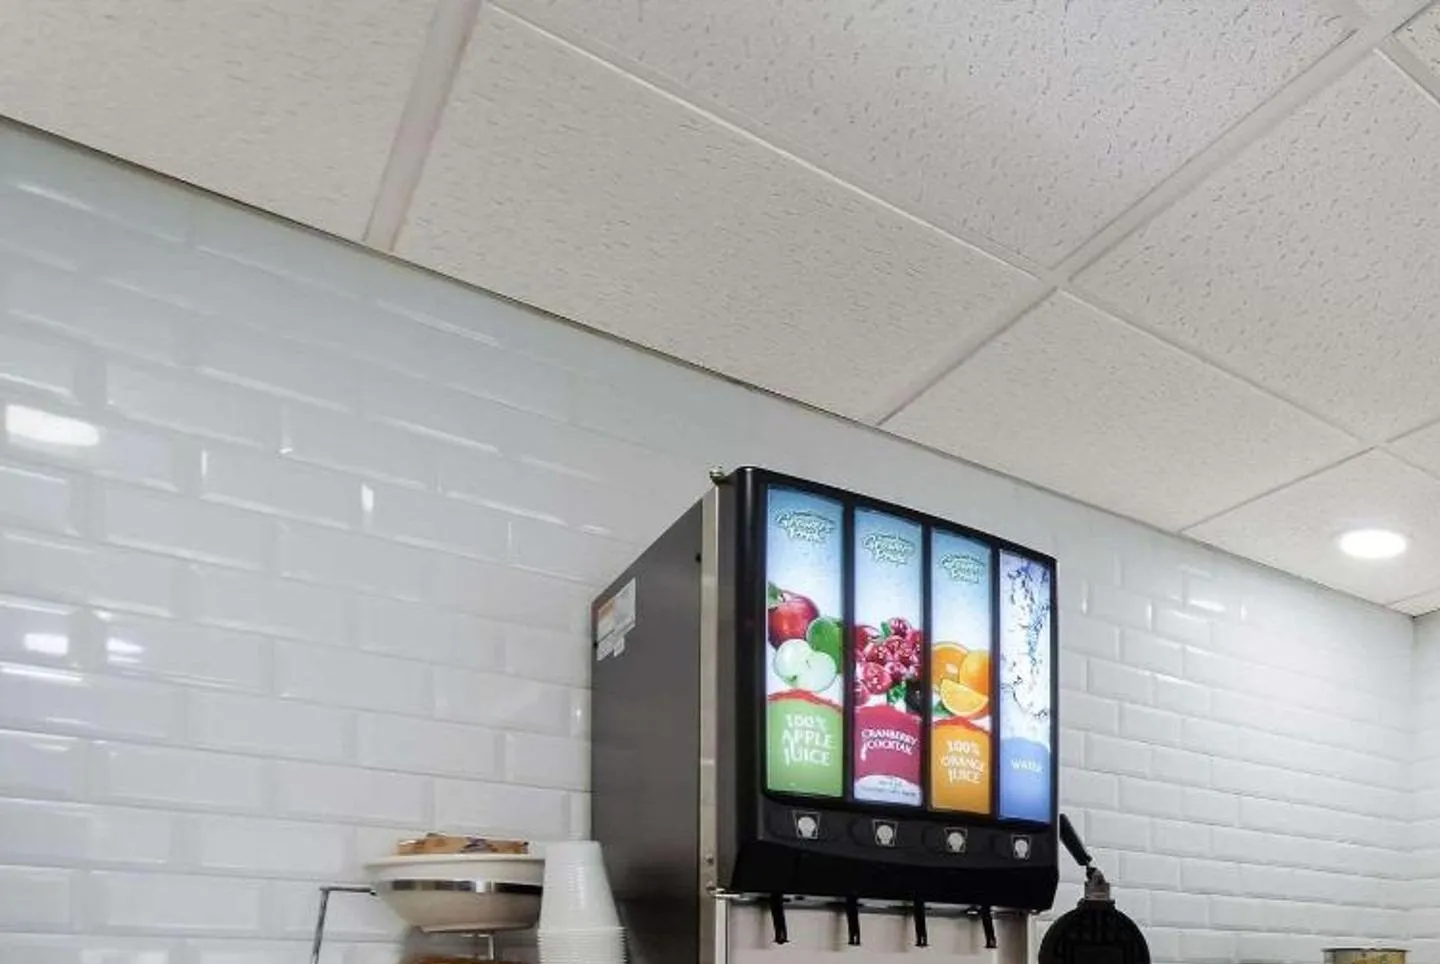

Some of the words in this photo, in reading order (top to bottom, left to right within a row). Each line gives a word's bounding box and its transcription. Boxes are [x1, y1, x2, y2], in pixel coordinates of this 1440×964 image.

[786, 713, 827, 731] 100%
[782, 729, 834, 750] APPLE
[861, 729, 918, 746] CRANBERRY
[784, 739, 831, 766] JUICE
